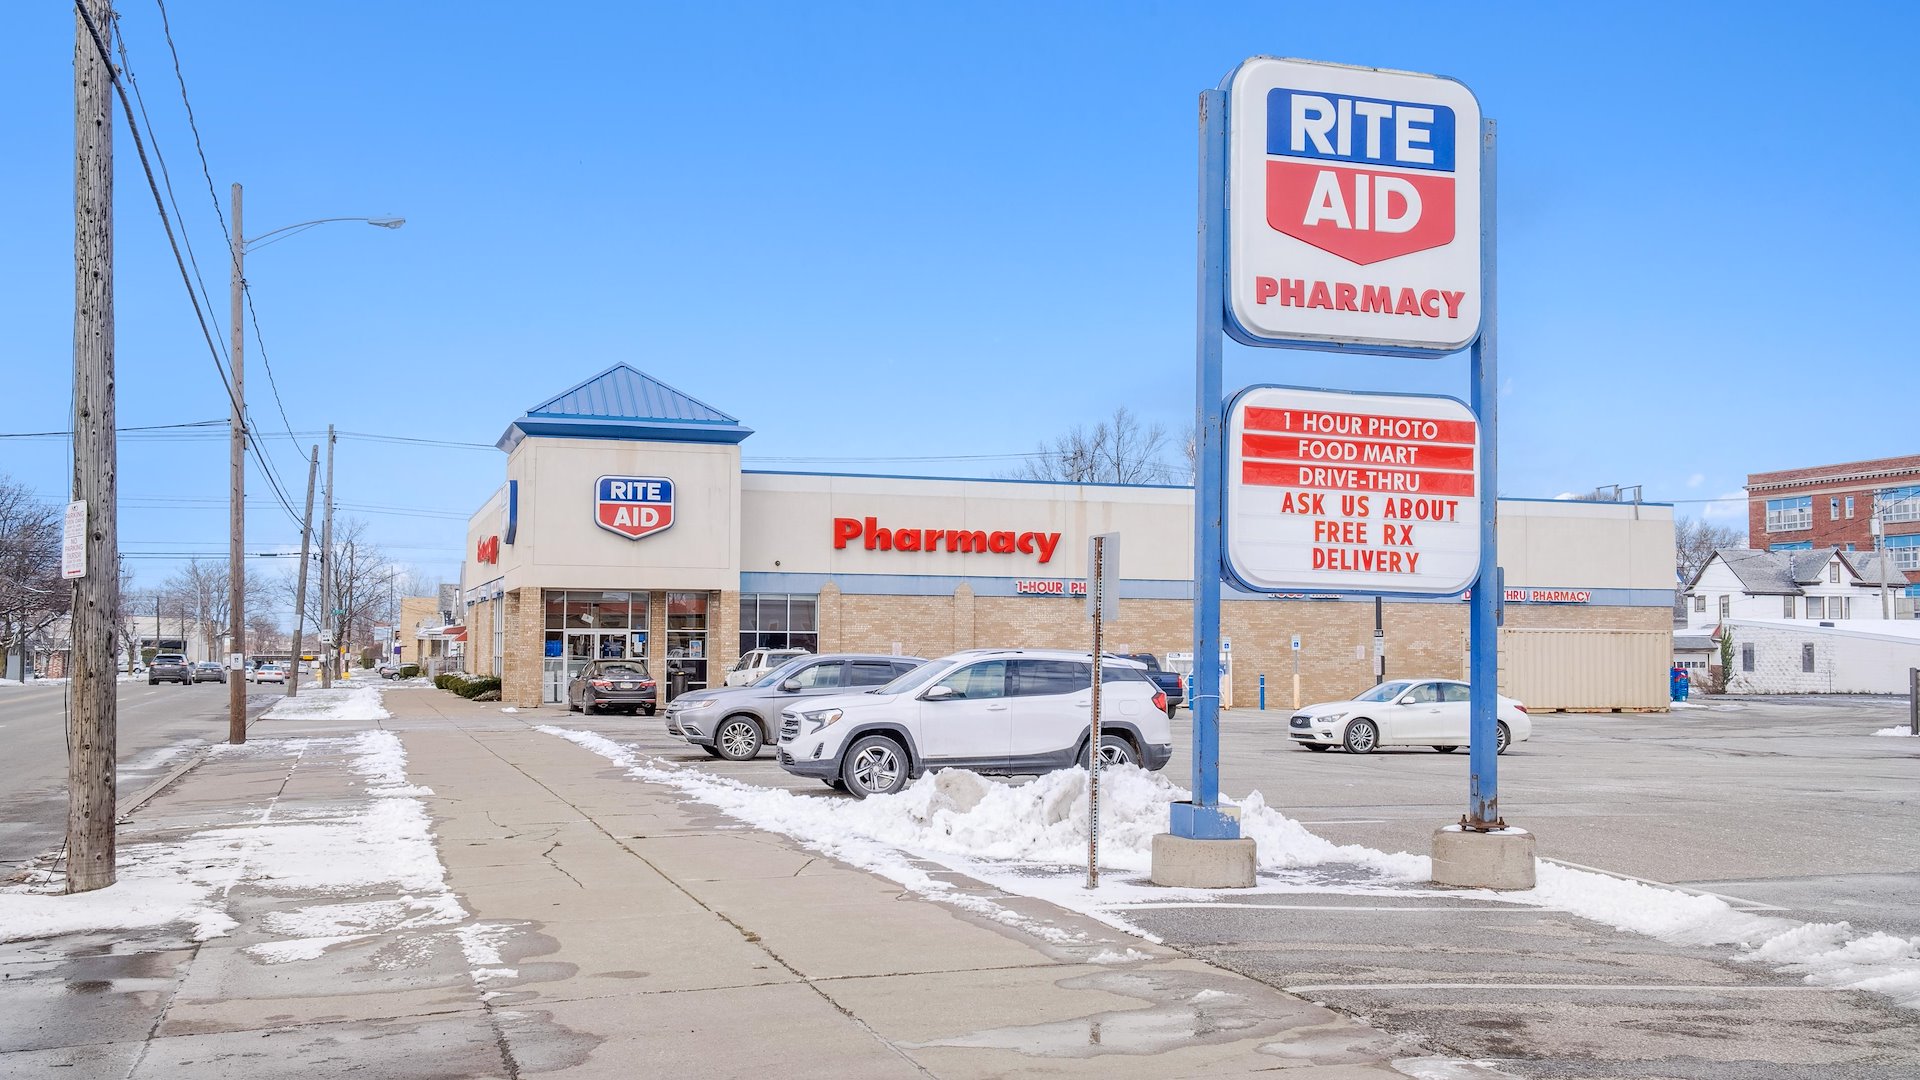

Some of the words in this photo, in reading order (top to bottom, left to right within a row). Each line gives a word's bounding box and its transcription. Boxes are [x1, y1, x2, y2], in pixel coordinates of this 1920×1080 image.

[1291, 94, 1435, 164] RITE
[1303, 170, 1423, 234] AID
[1256, 276, 1465, 318] PHARMACY
[1284, 412, 1291, 430] 1
[1303, 413, 1362, 435] HOUR
[1368, 420, 1438, 440] PHOTO
[1298, 440, 1357, 461] FOOD
[1363, 444, 1418, 465] MART
[610, 481, 662, 501] RITE
[1299, 467, 1420, 491] DRIVE-THRU
[613, 506, 660, 527] AID
[1281, 492, 1325, 515] ASK
[1341, 495, 1370, 517] US
[1384, 498, 1459, 522] ABOUT
[833, 516, 1062, 564] Pharmacy
[1314, 521, 1368, 544] FREE
[1383, 525, 1414, 546] RX
[1312, 548, 1420, 572] DELIVERY
[1017, 581, 1063, 593] 1-HOUR
[1532, 591, 1591, 602] PHARMACY
